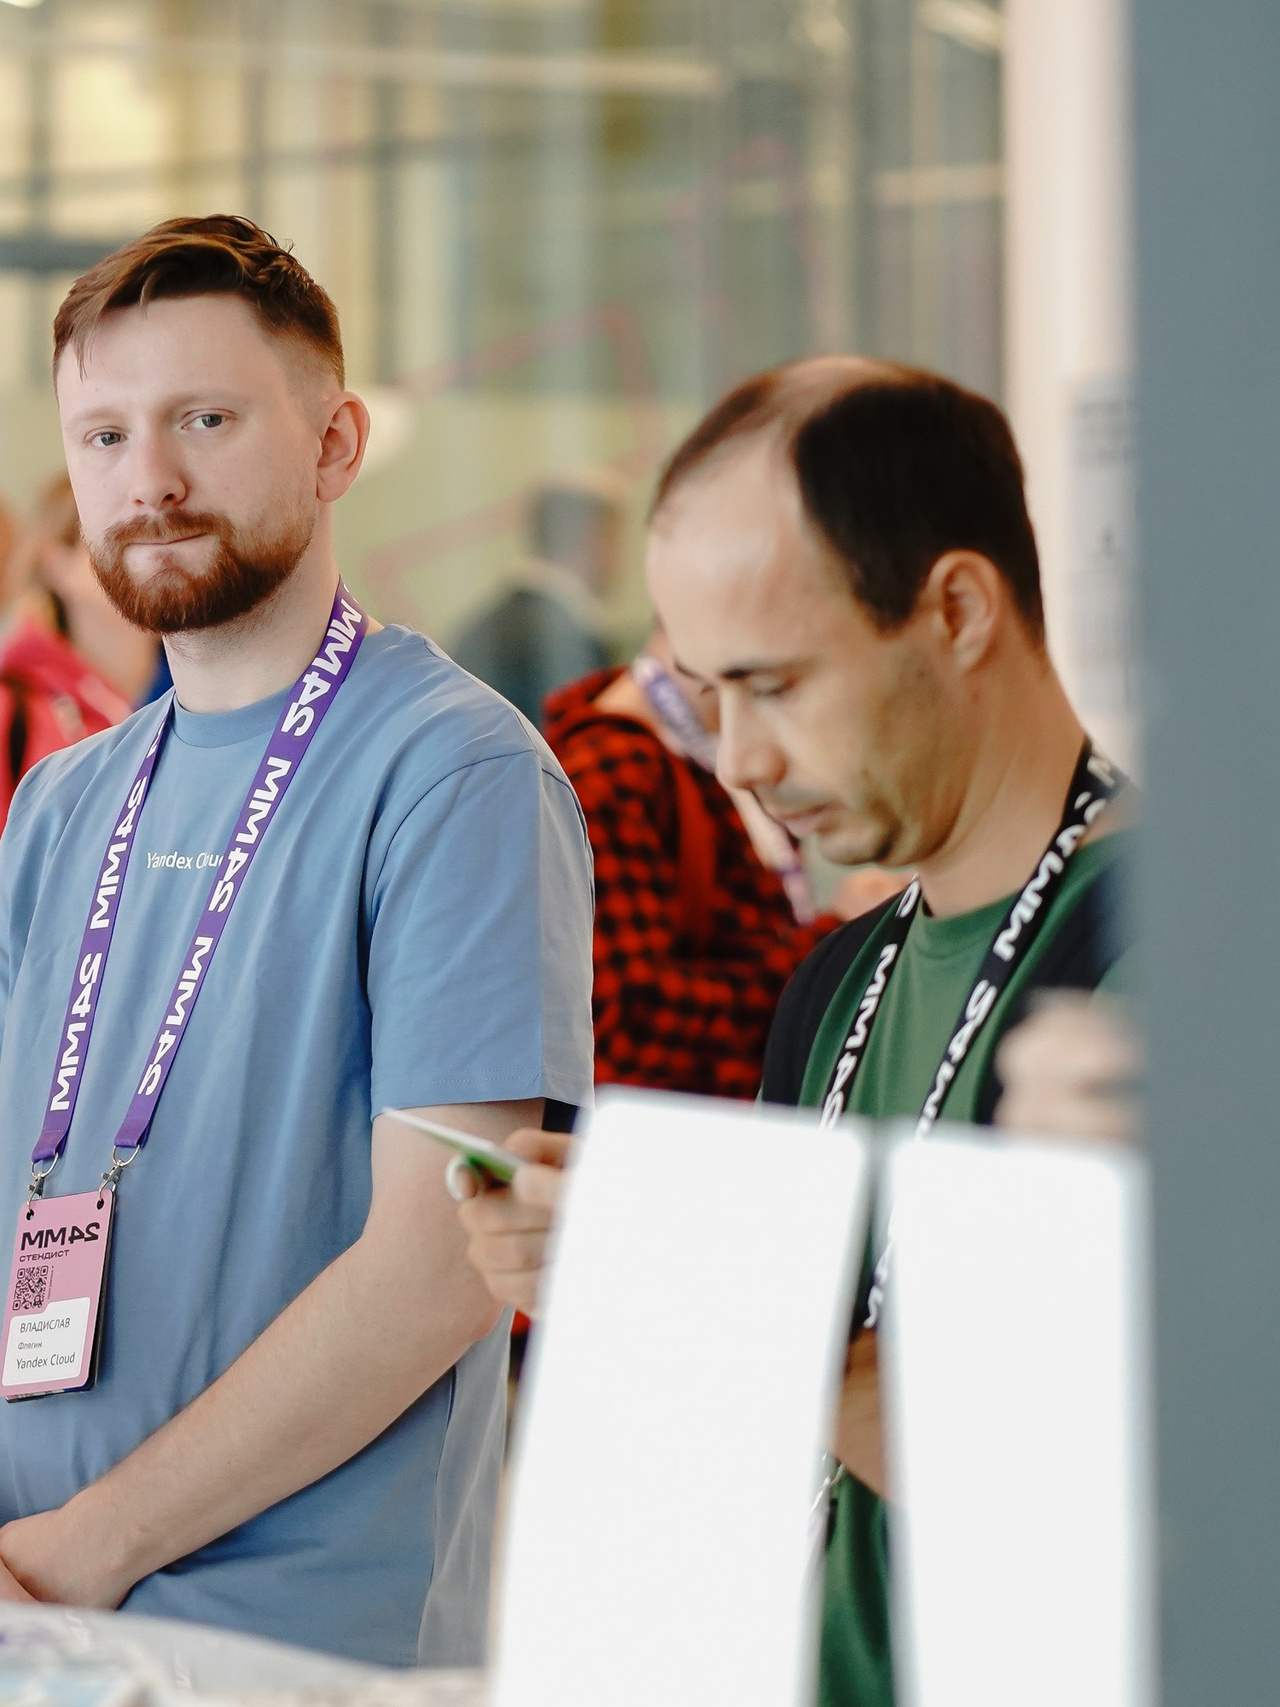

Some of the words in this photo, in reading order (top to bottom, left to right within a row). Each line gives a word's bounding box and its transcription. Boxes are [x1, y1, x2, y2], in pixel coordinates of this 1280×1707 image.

[147, 851, 194, 870] Yandex
[19, 1249, 70, 1262] СТЕНДИСТ
[20, 1317, 71, 1333] ВЛАДИСЛАВ
[16, 1356, 48, 1369] Yandex
[50, 1351, 76, 1366] Cloud
